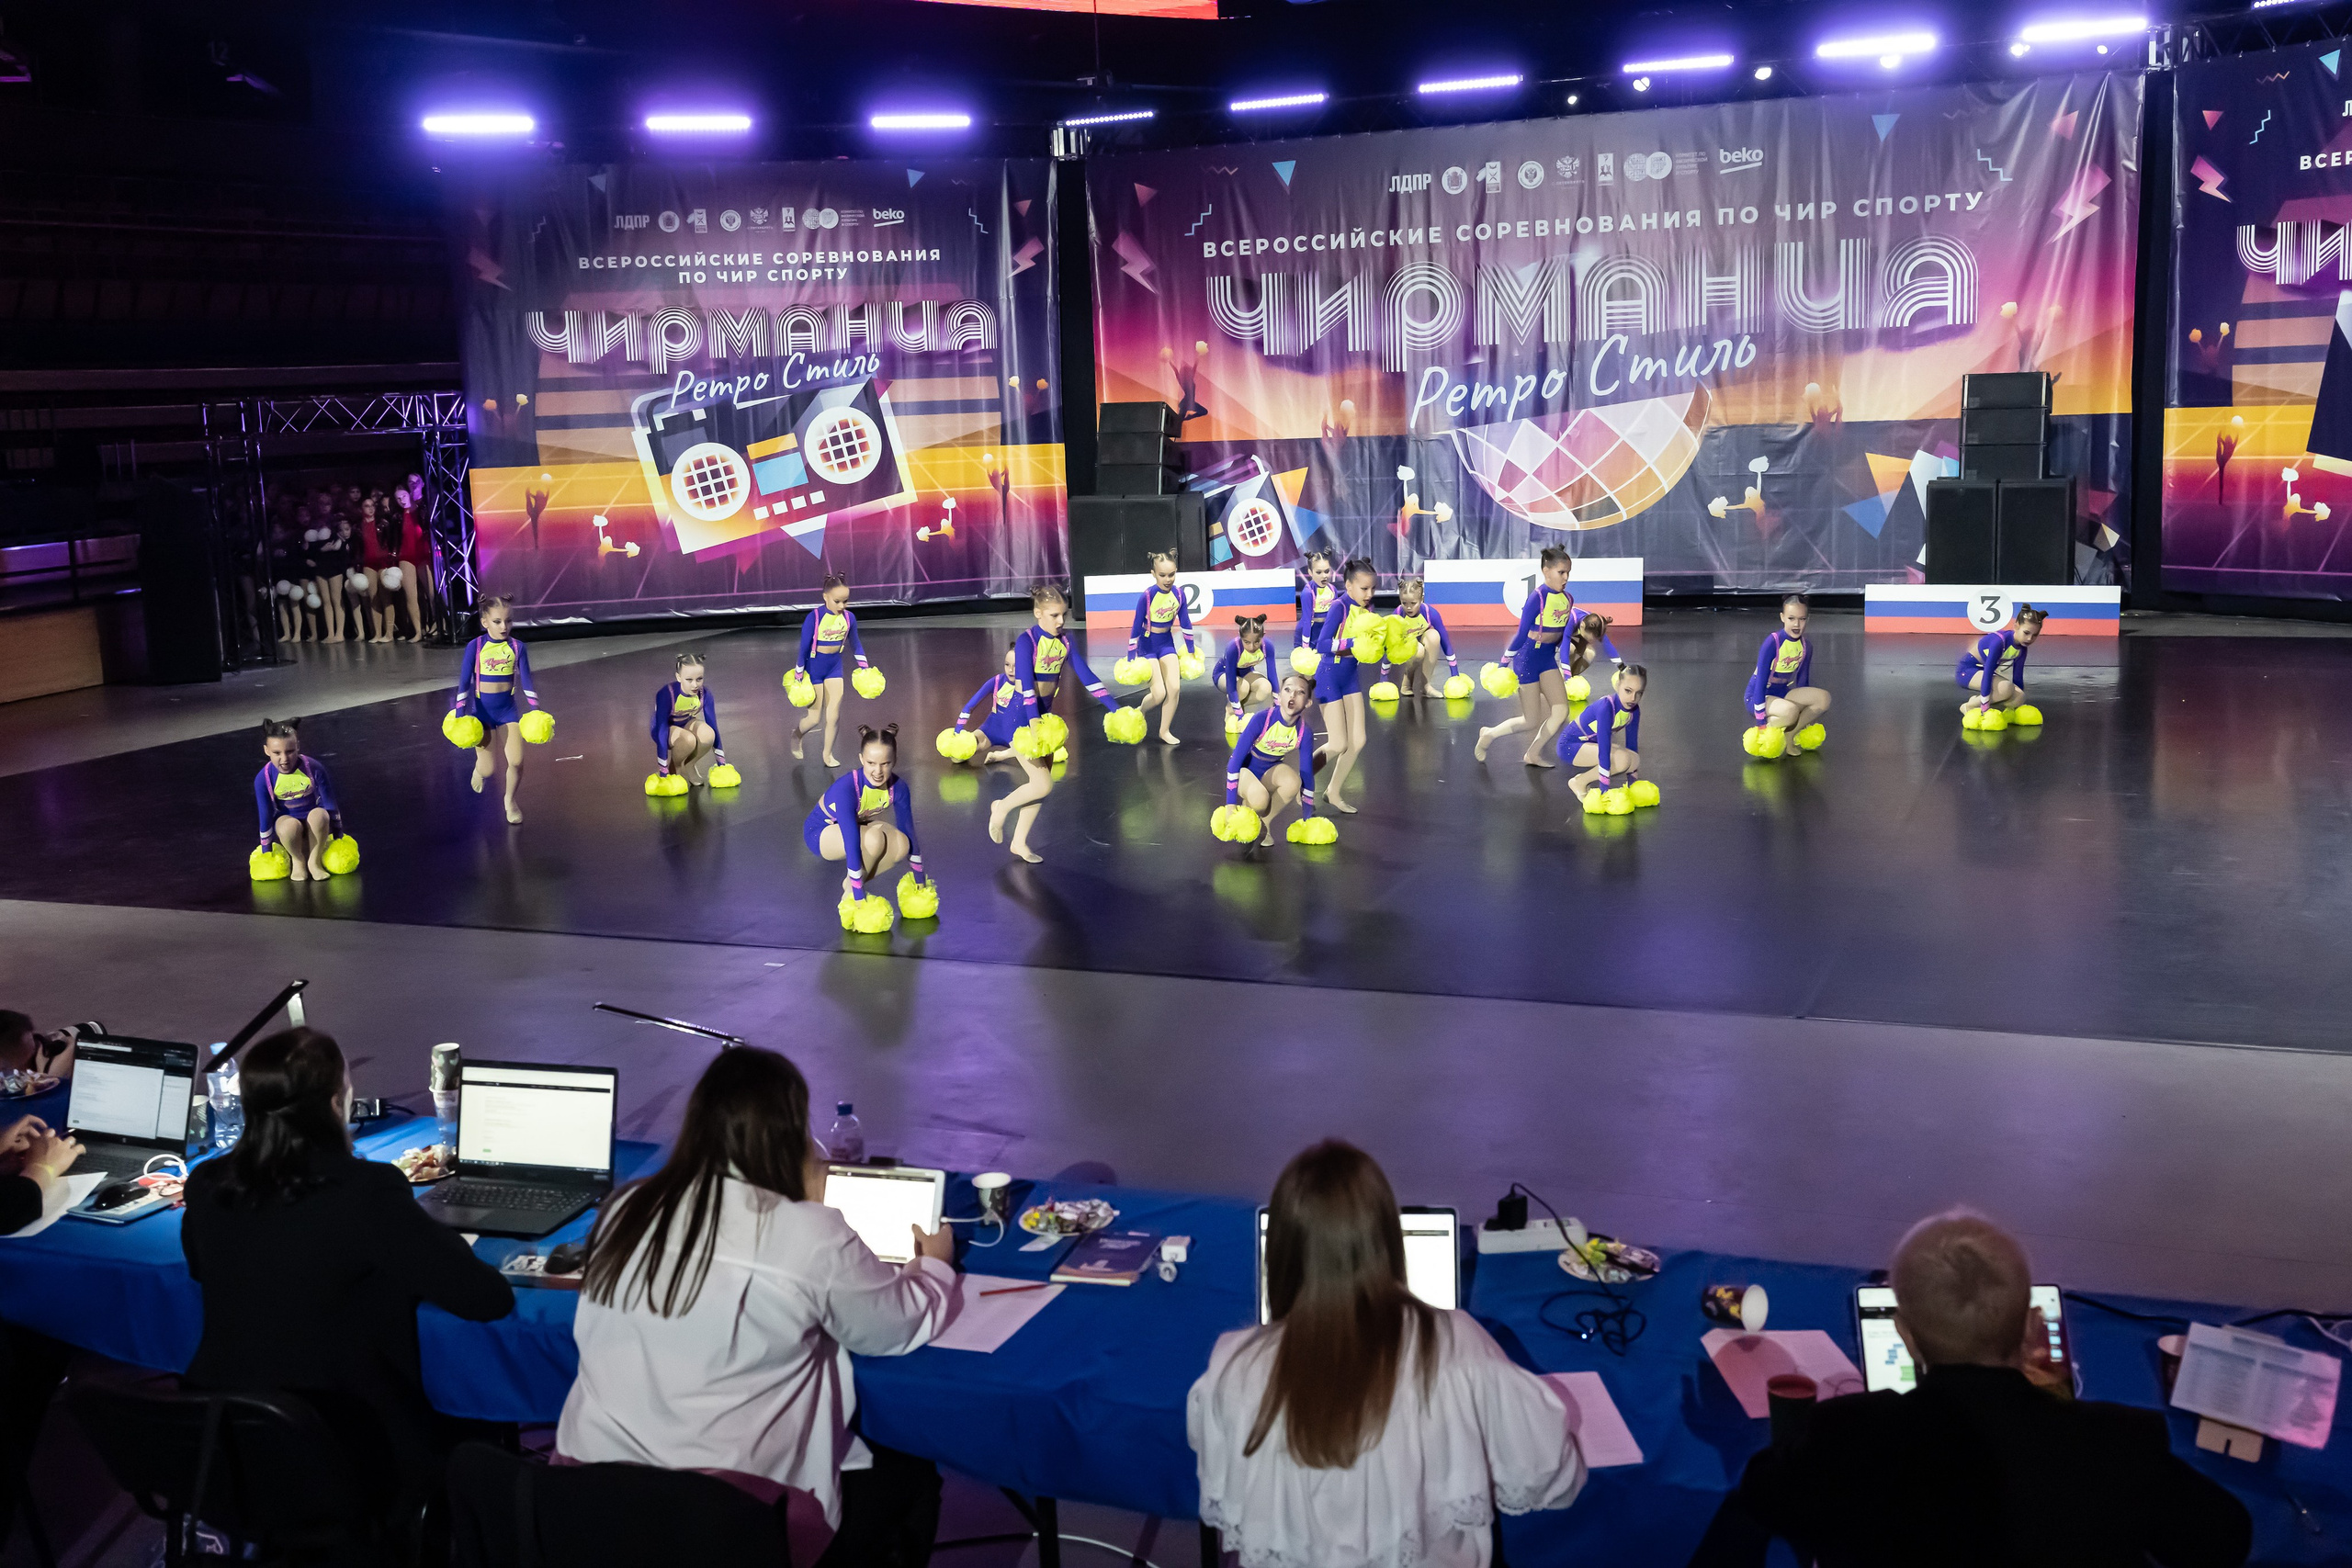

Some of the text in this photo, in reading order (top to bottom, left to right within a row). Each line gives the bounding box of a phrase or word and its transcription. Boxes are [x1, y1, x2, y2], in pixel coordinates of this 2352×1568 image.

[1719, 147, 1764, 164] beko
[1388, 173, 1431, 194] ЛДПР
[614, 215, 650, 230] ЛДПР
[873, 208, 905, 220] beko
[1203, 191, 1984, 258] ВСЕРОССИЙСКИЕ СОРЕВНОВАНИЯ ПО ЧИР СПОРТУ
[579, 249, 941, 269] ВСЕРОССИЙСКИЕ СОРЕВНОВАНИЯ
[678, 267, 848, 284] ПО ЧИР СПОРТУ
[671, 351, 881, 410] Ретро Стиль
[1410, 333, 1757, 429] Ретро Стиль
[1179, 583, 1202, 615] 2
[1979, 595, 2002, 625] 3
